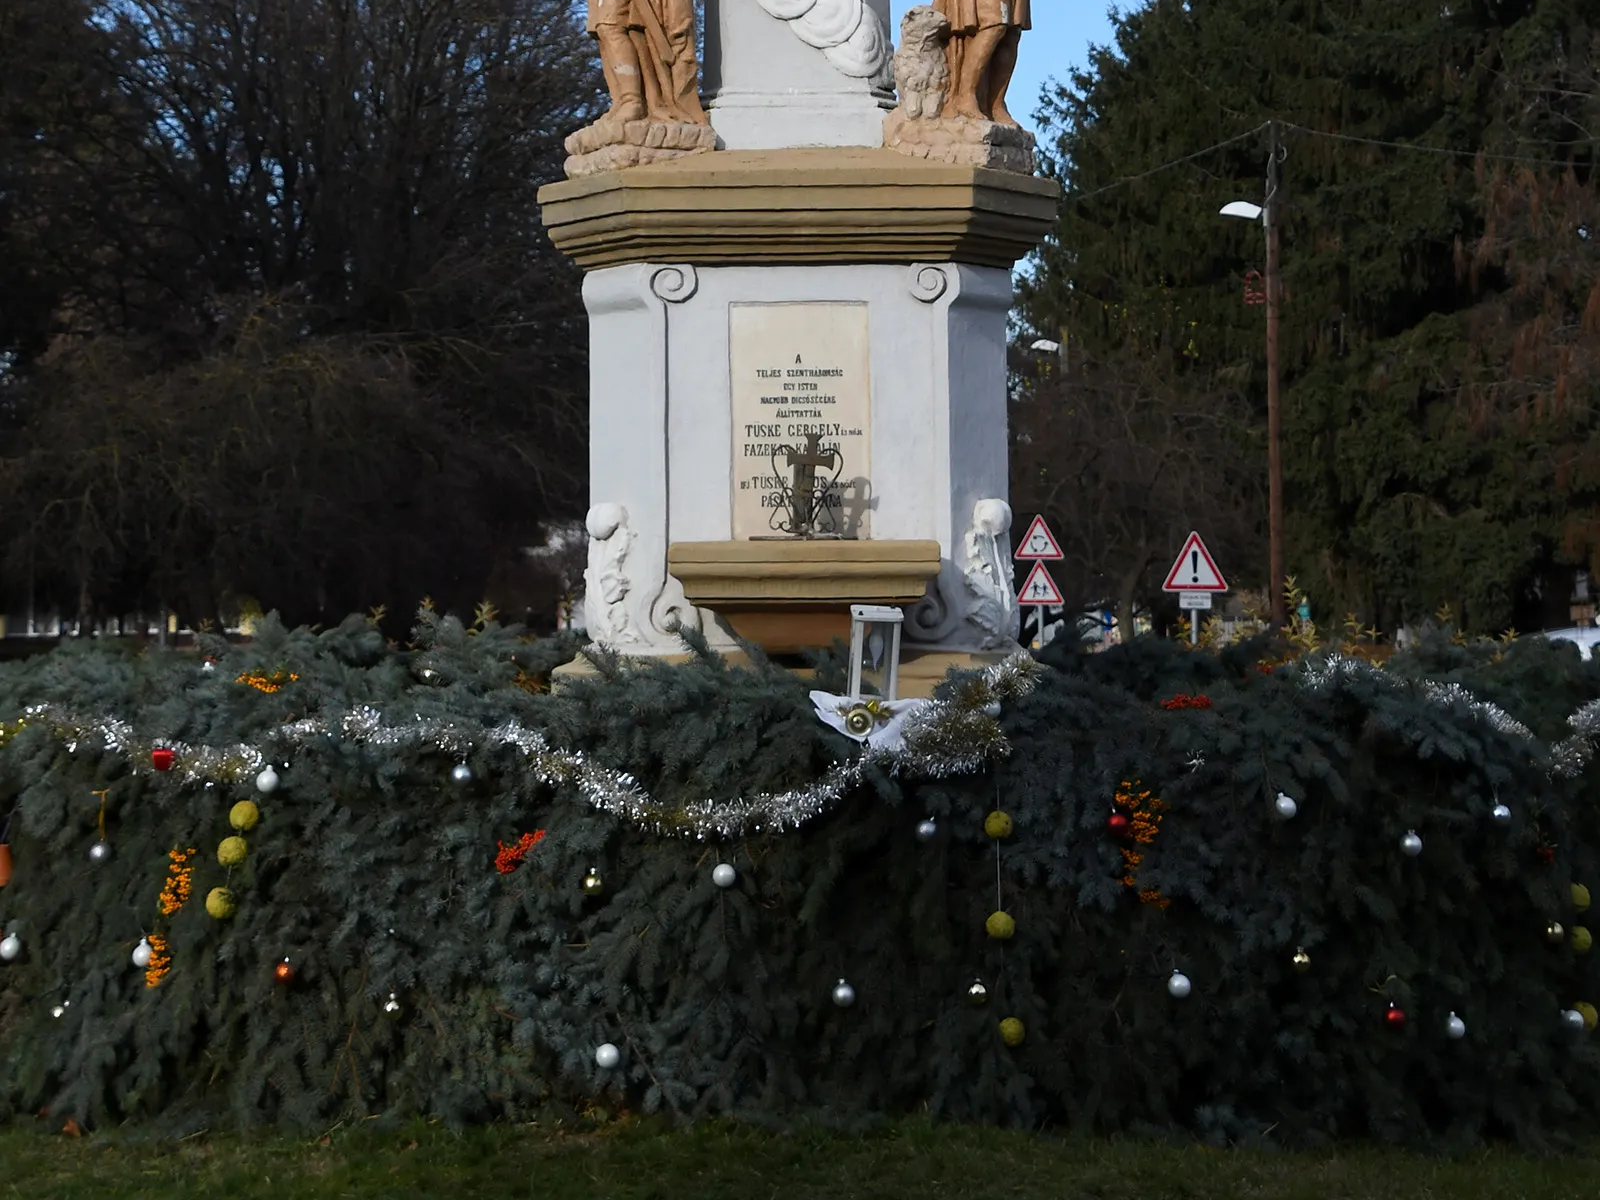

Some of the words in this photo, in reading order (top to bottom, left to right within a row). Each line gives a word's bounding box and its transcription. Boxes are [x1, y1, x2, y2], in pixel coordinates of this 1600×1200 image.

[795, 354, 802, 364] A
[756, 369, 782, 378] TELJES
[797, 382, 818, 391] ISTEN
[744, 420, 782, 438] TÜSKE
